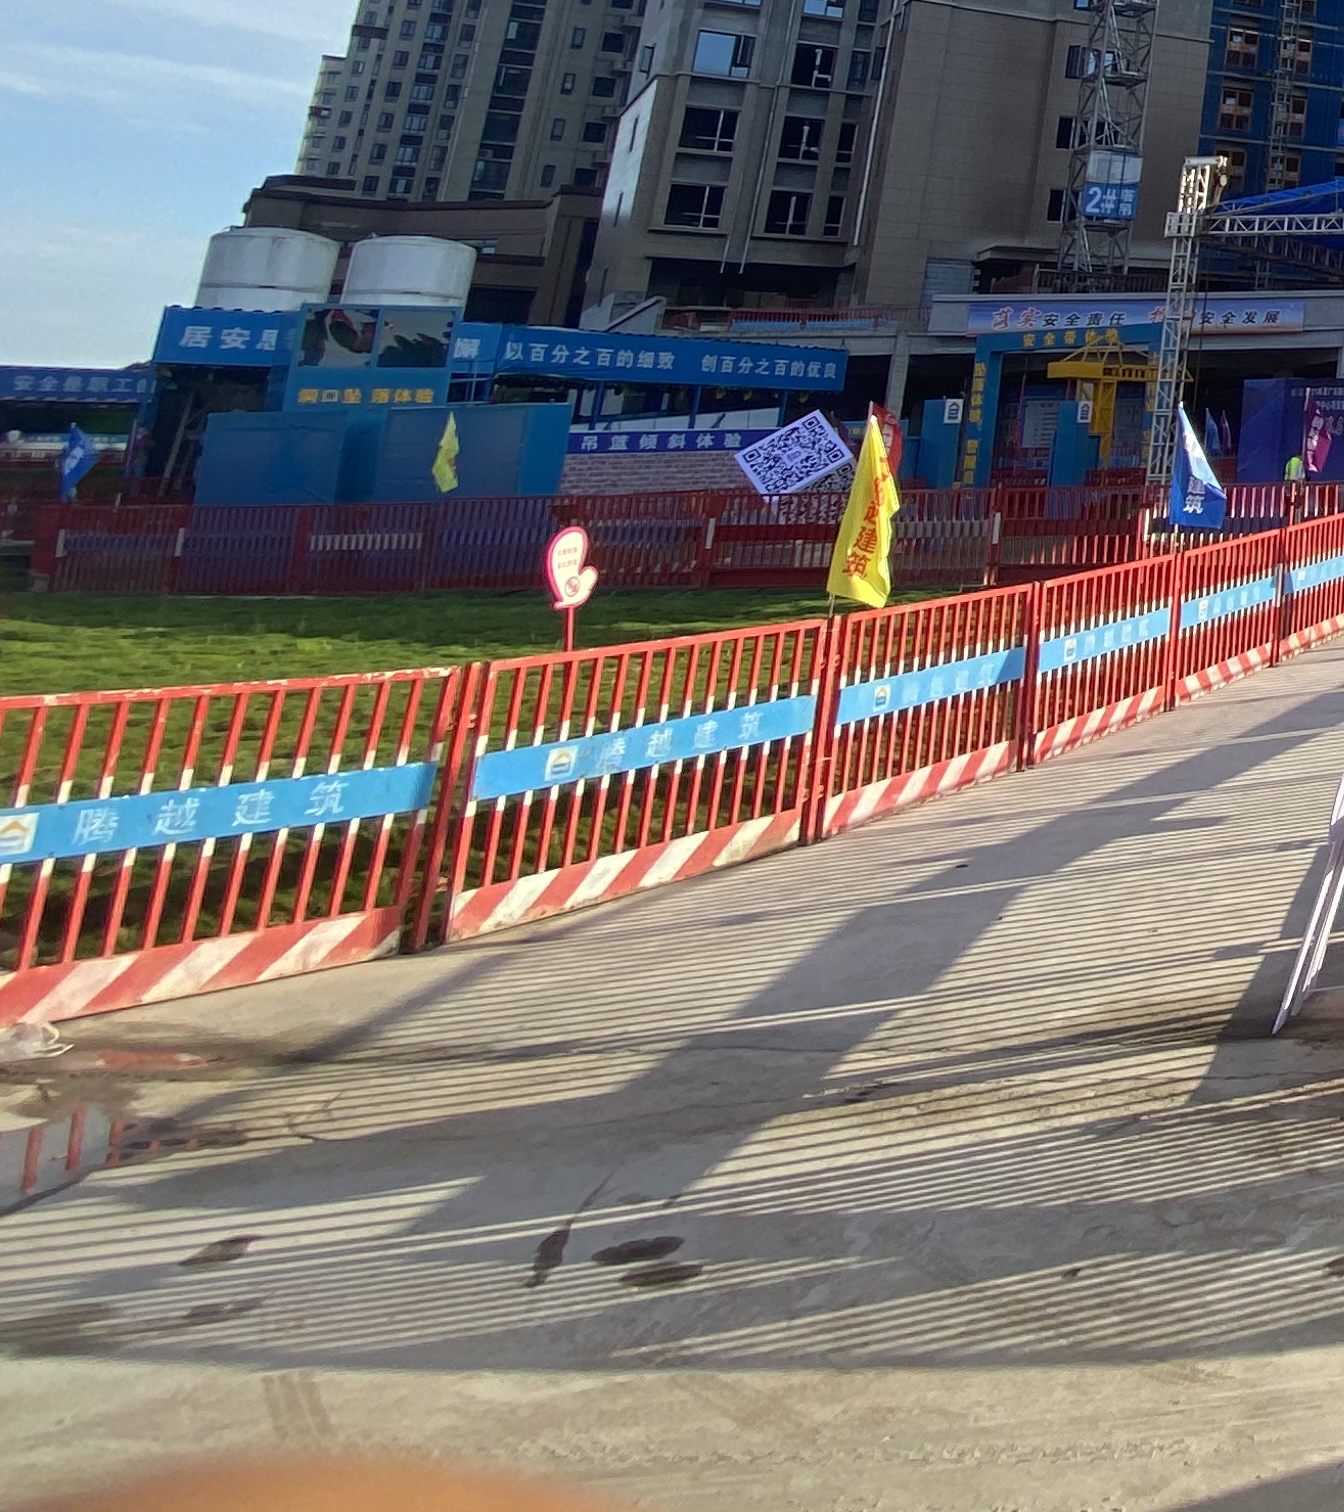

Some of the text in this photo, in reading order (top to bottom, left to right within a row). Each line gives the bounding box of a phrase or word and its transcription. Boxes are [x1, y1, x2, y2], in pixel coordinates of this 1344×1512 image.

[992, 306, 1126, 330] 落实安全责任
[503, 340, 837, 379] 以百分之百的细致 创百分之百的优良
[580, 432, 743, 451] 吊篮倾斜体验
[71, 780, 351, 847] 腾越建筑
